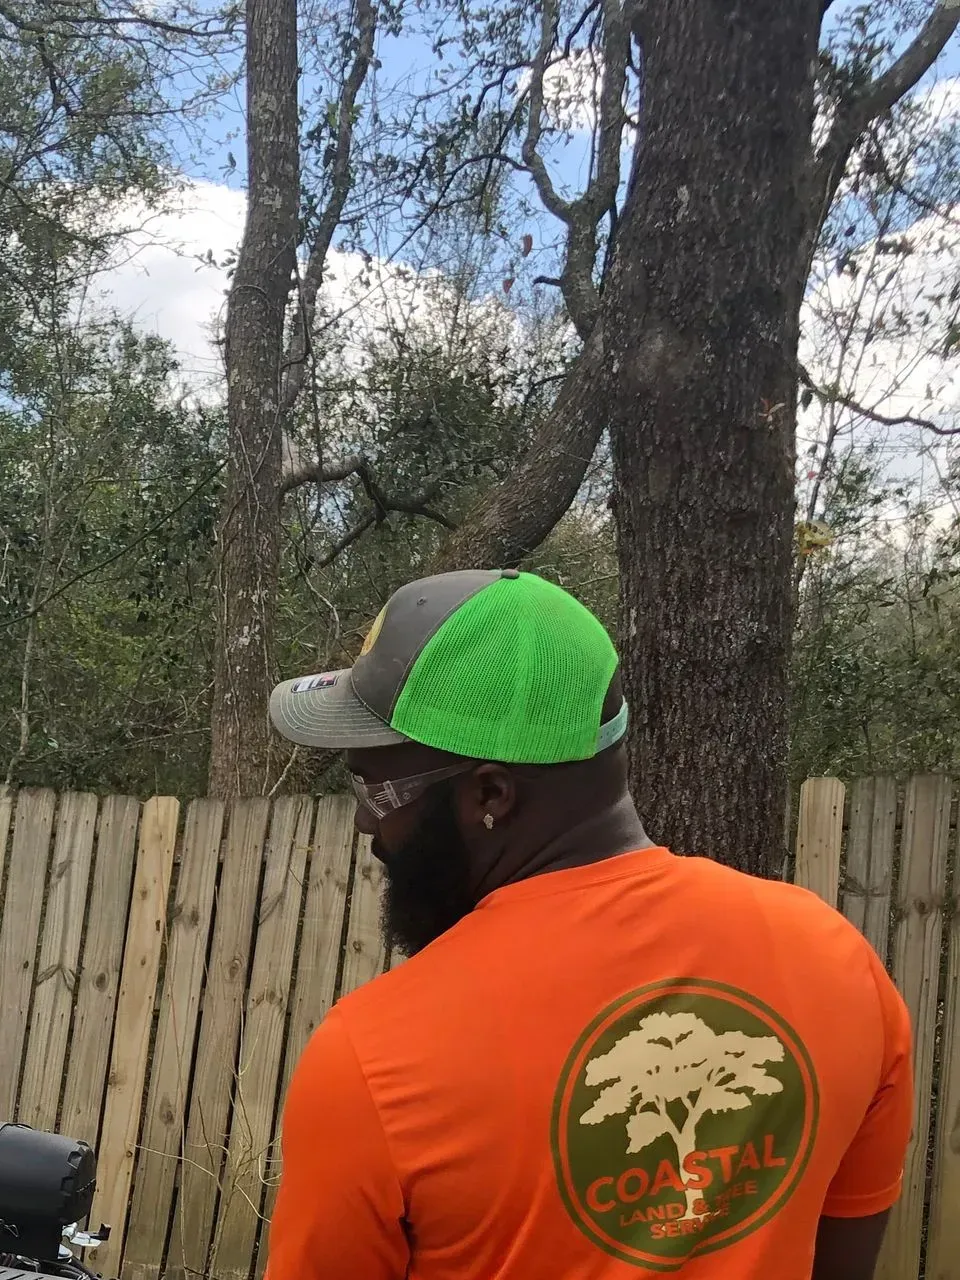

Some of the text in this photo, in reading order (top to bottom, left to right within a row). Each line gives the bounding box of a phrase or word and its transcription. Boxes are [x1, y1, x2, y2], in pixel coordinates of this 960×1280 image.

[586, 1134, 786, 1213] COASTAL
[620, 1202, 685, 1227] LAND
[692, 1197, 708, 1216] &
